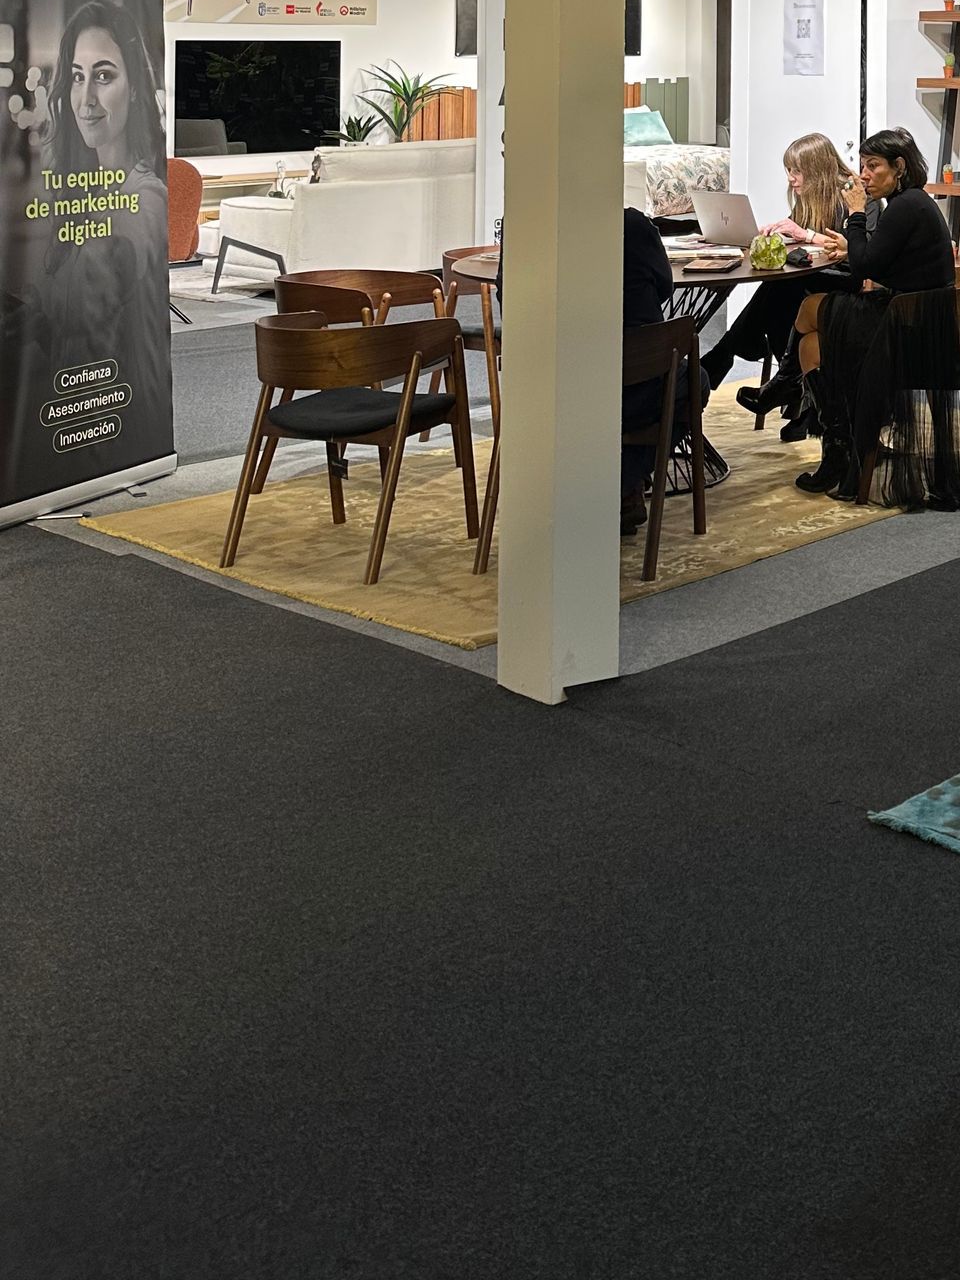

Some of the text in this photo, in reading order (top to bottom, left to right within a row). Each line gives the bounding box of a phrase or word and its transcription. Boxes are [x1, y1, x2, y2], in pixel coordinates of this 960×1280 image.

[41, 166, 125, 192] Tu equipo
[26, 190, 139, 219] de marketing
[58, 217, 112, 245] digital
[61, 367, 111, 387] Confianza
[48, 391, 125, 420] Asesoramiento
[60, 421, 115, 446] Innovación
